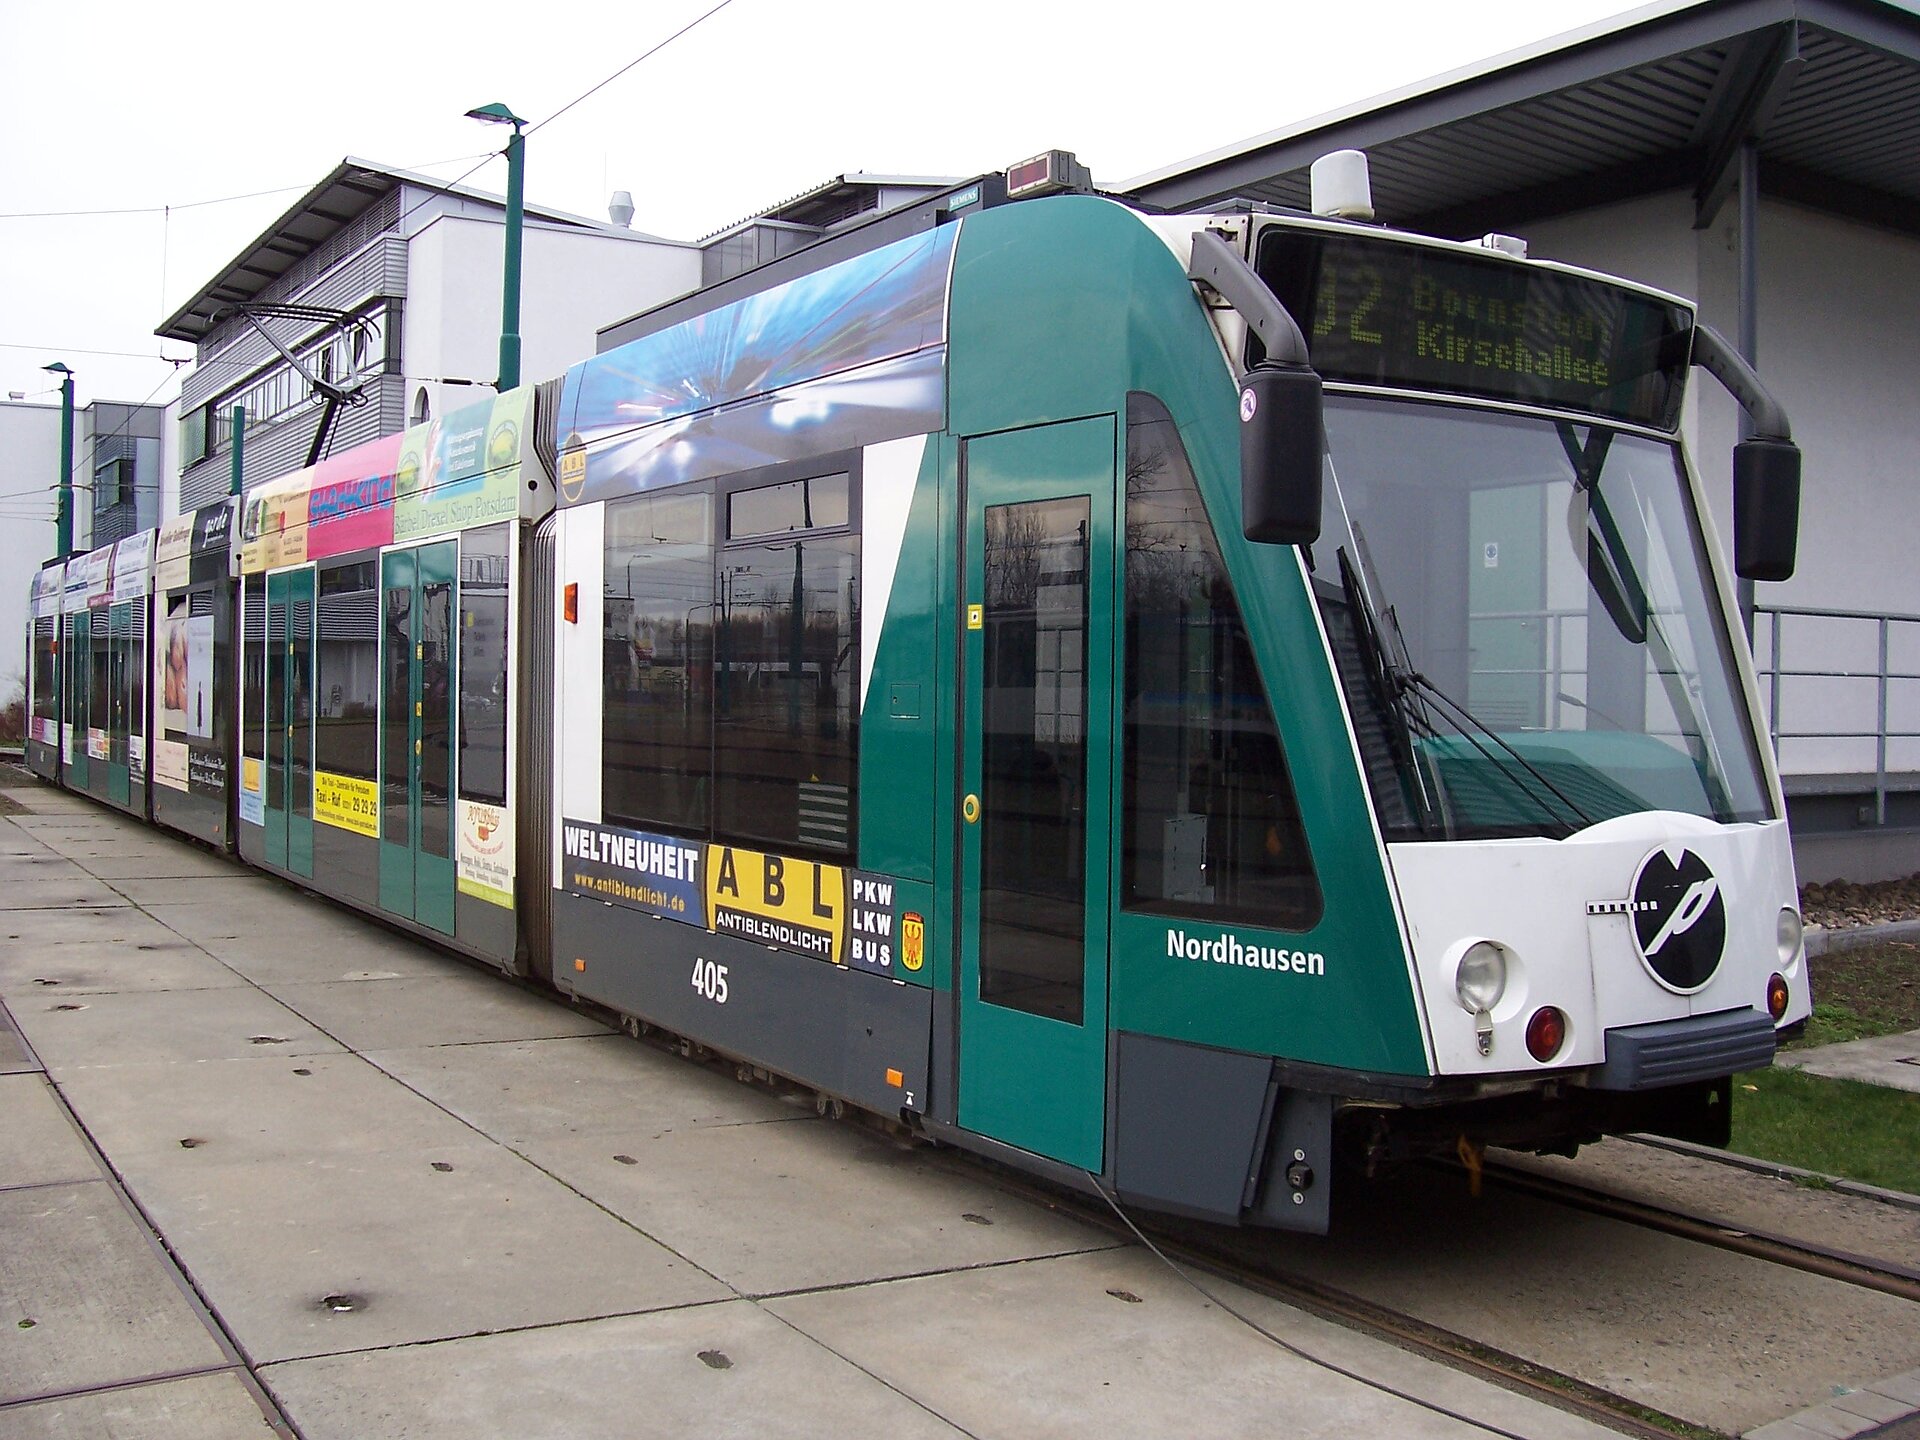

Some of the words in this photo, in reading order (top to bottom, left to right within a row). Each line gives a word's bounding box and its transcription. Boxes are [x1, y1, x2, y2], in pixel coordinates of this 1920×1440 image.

[950, 189, 977, 208] SIEMENS
[1415, 319, 1610, 387] Kirschallee
[475, 491, 517, 519] Potsdam
[315, 787, 328, 804] Taxi
[331, 791, 341, 807] Ruf
[352, 796, 360, 812] 29
[361, 798, 368, 815] 29
[369, 800, 377, 817] 29
[564, 825, 699, 883] WELTNEUHEIT
[574, 872, 686, 913] www.antiblendlicht.de
[852, 878, 893, 907] PKW
[715, 910, 832, 955] ANTIBLENDLICHT
[852, 908, 892, 937] LKW
[851, 937, 891, 968] BUS
[1166, 928, 1326, 977] Nordhausen
[690, 956, 730, 1005] 405
